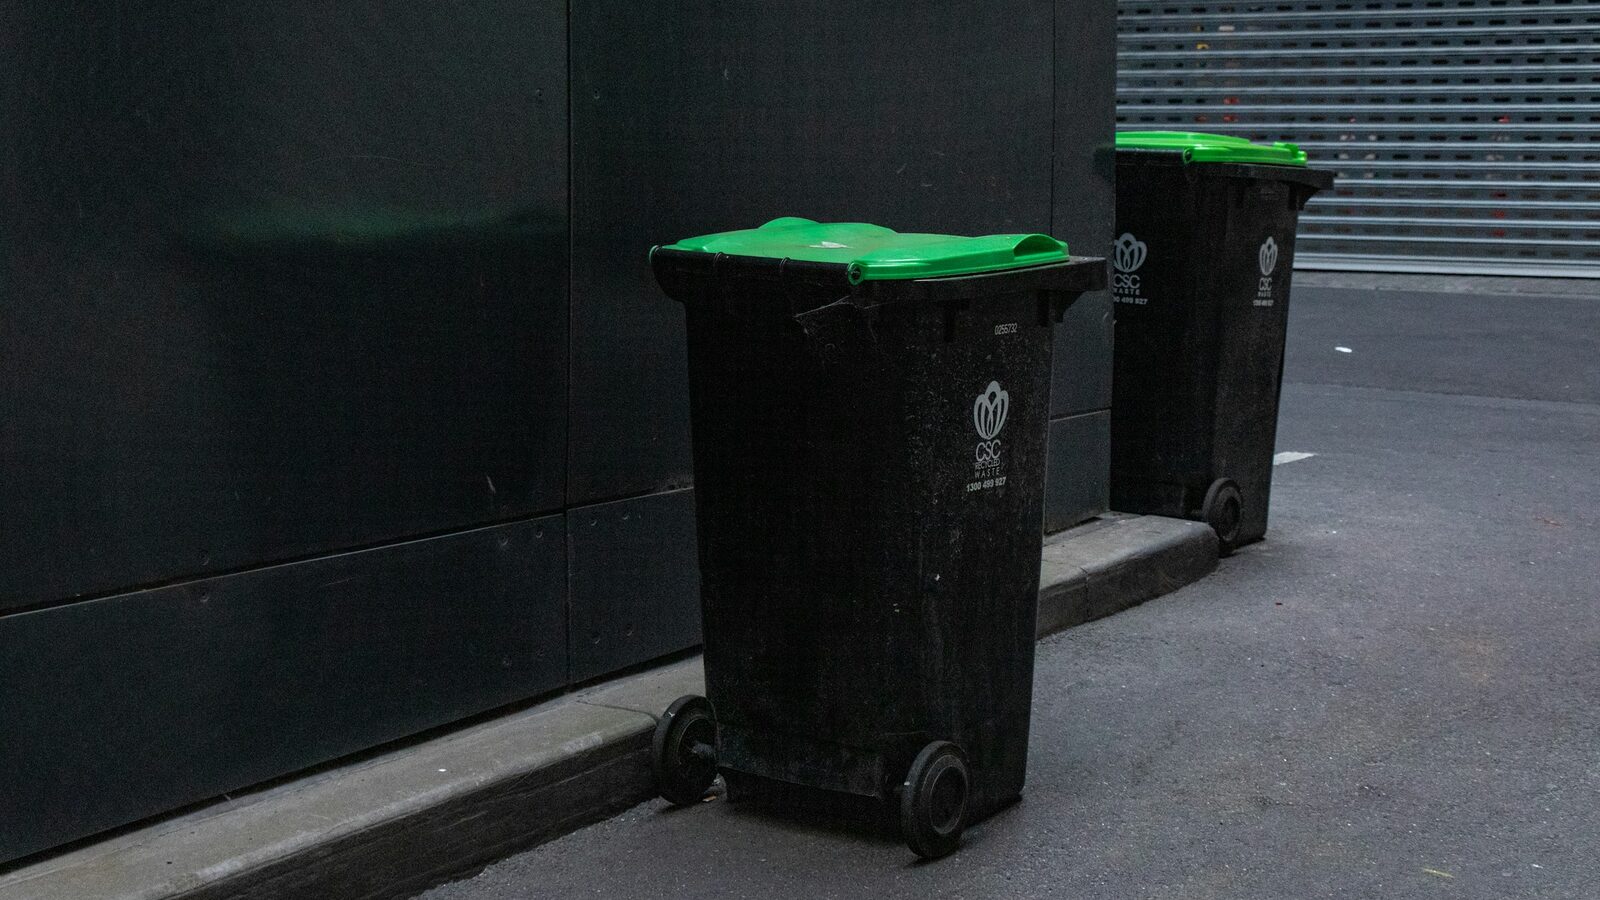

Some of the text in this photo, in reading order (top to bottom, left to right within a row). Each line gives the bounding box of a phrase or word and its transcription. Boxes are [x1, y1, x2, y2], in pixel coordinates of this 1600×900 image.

[1113, 273, 1140, 288] CSC
[1259, 277, 1272, 291] CSC
[976, 440, 1001, 461] CSC
[975, 467, 1000, 478] WASTE
[967, 482, 981, 492] 1300
